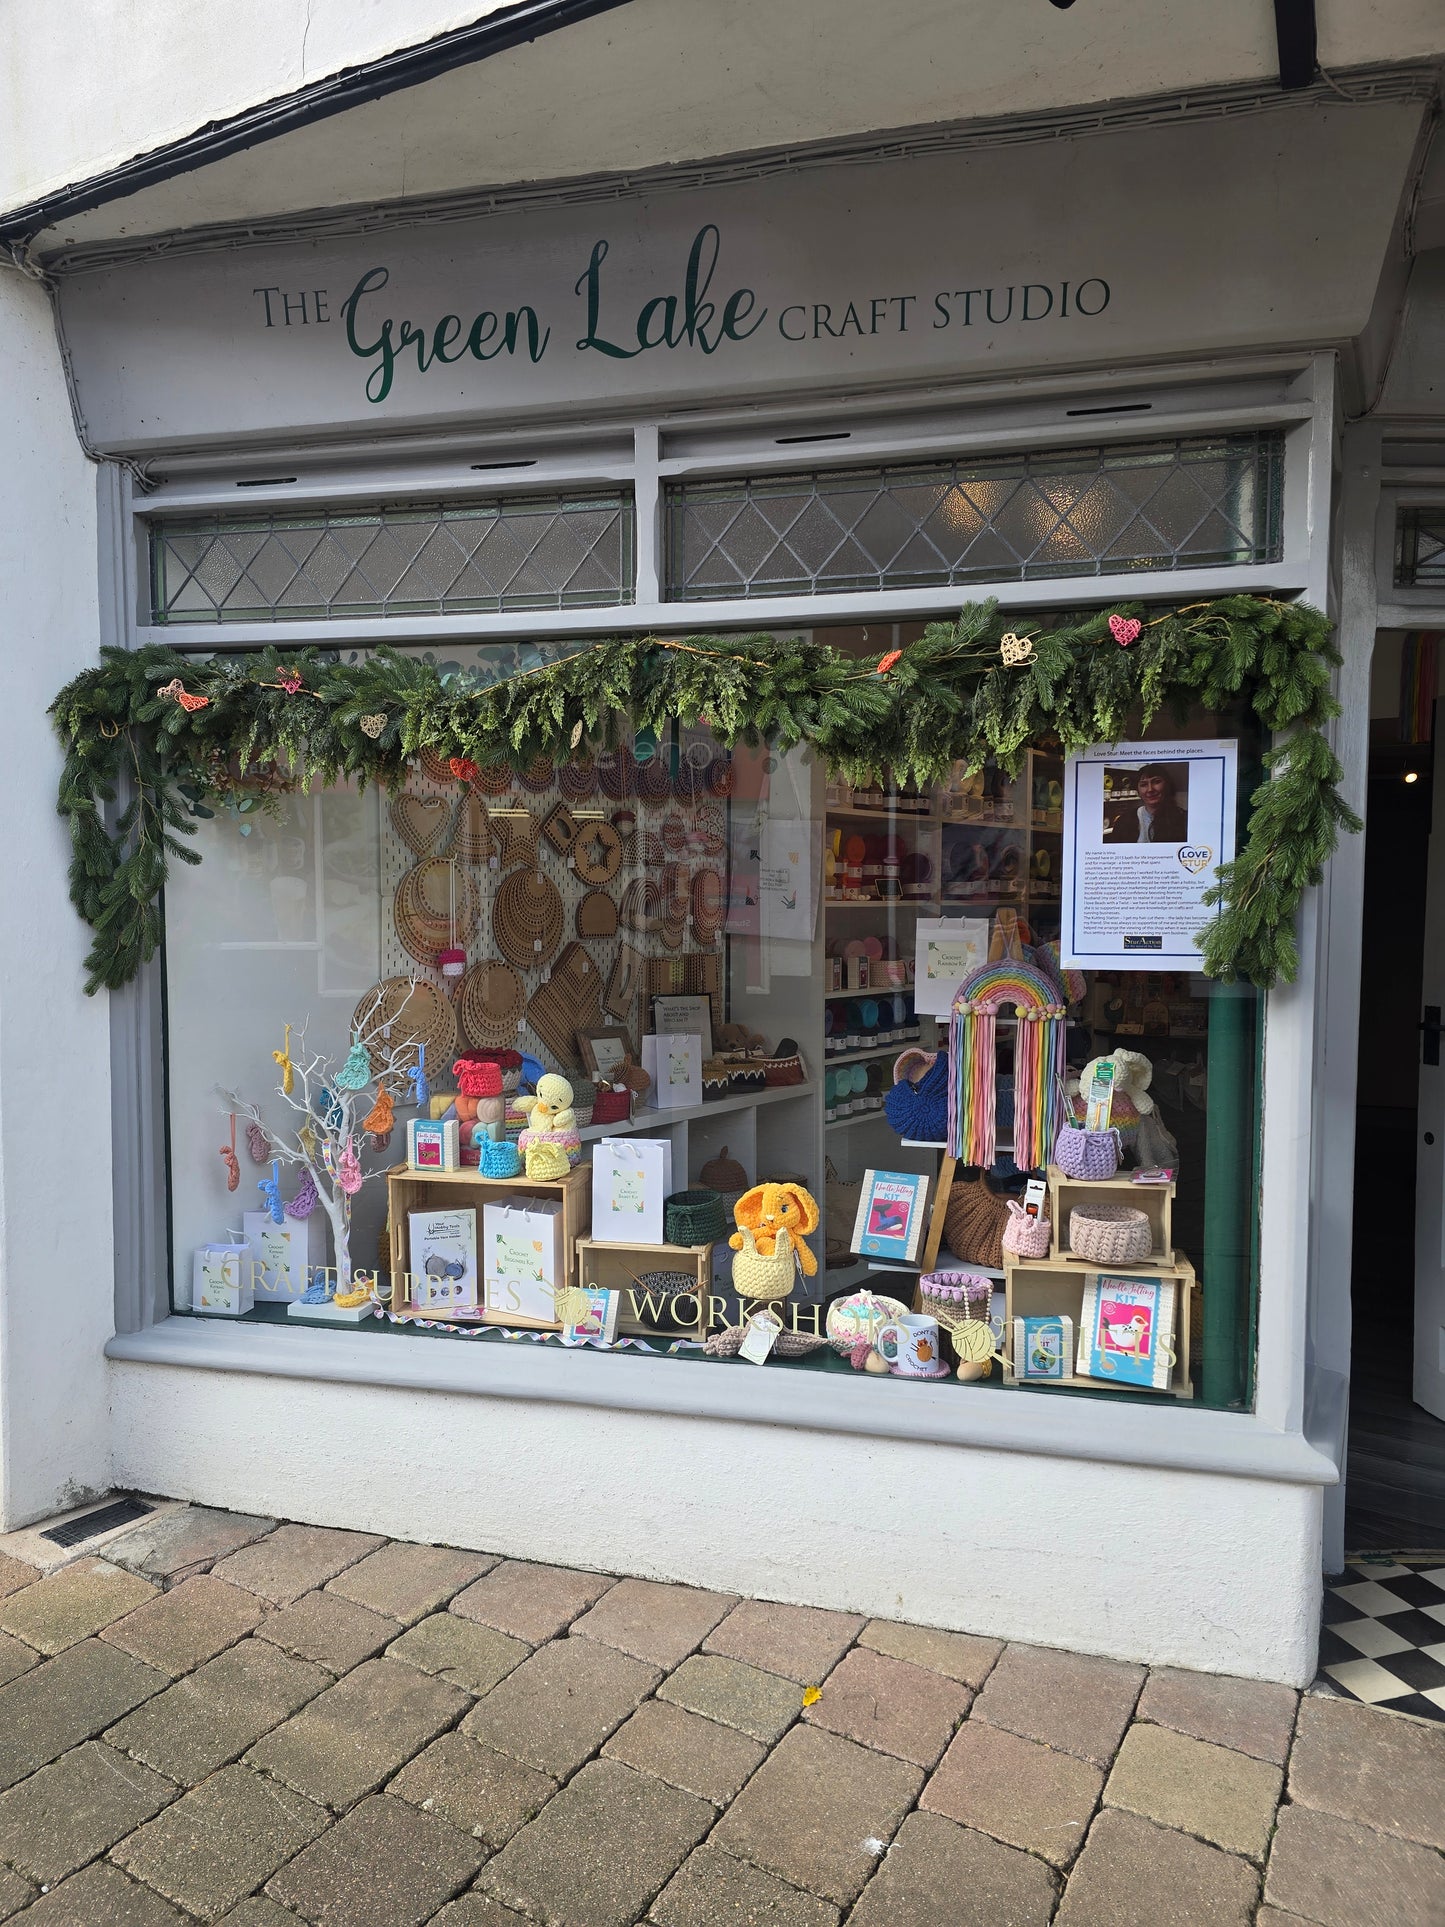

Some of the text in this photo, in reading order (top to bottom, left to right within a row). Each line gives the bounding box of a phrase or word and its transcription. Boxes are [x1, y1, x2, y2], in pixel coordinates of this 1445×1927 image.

[254, 224, 1112, 403] THE Green Lake CRAFT STUDIO
[221, 1260, 521, 1312] CRAFT SUPPLIES
[1102, 1280, 1155, 1299] Needle Felting
[1116, 1293, 1137, 1304] KIT
